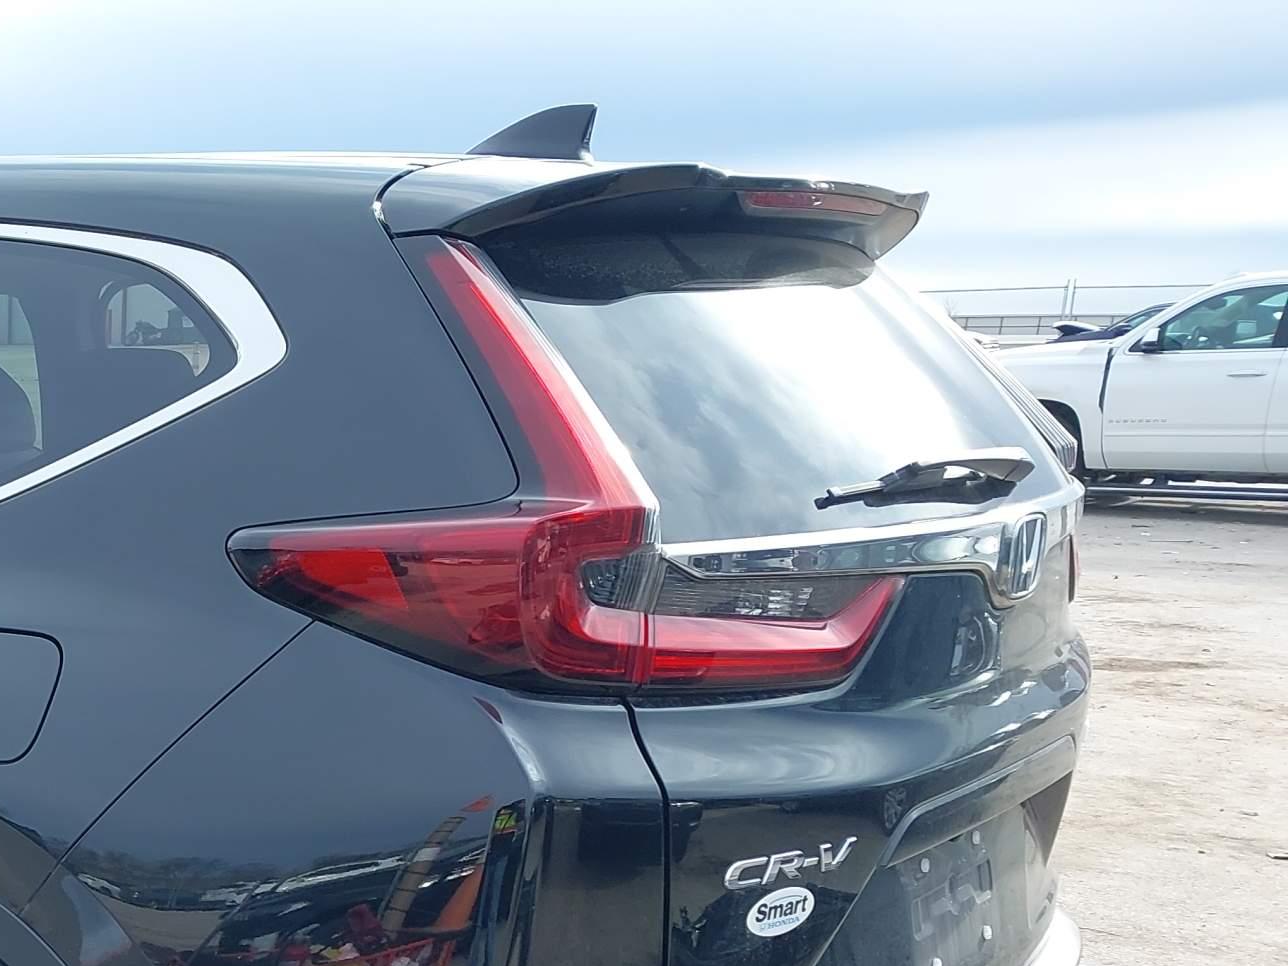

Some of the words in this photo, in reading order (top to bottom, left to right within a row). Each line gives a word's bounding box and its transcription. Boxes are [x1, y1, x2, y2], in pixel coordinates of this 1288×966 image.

[724, 836, 858, 890] CR-V
[755, 895, 808, 923] Smart
[767, 916, 800, 929] HONDA
